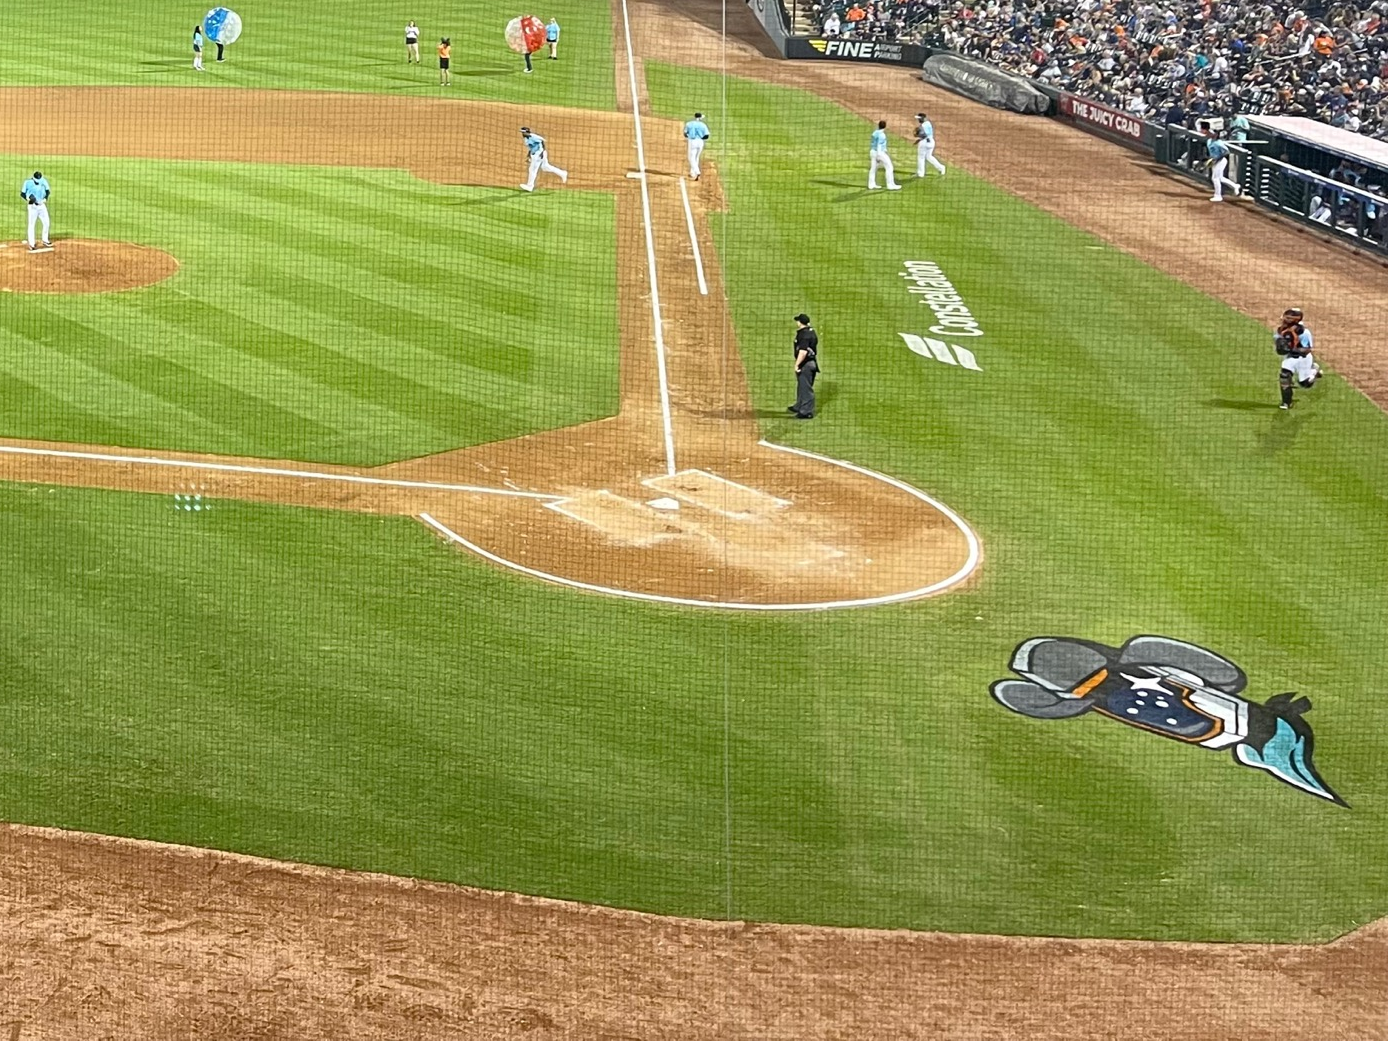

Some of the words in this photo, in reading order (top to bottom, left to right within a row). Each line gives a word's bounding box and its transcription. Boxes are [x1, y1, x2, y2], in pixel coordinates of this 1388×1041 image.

[825, 40, 874, 57] FINE
[1072, 100, 1088, 118] THE
[1089, 106, 1114, 127] JUICY
[1115, 116, 1141, 138] CRAB
[898, 260, 984, 336] Constellation
